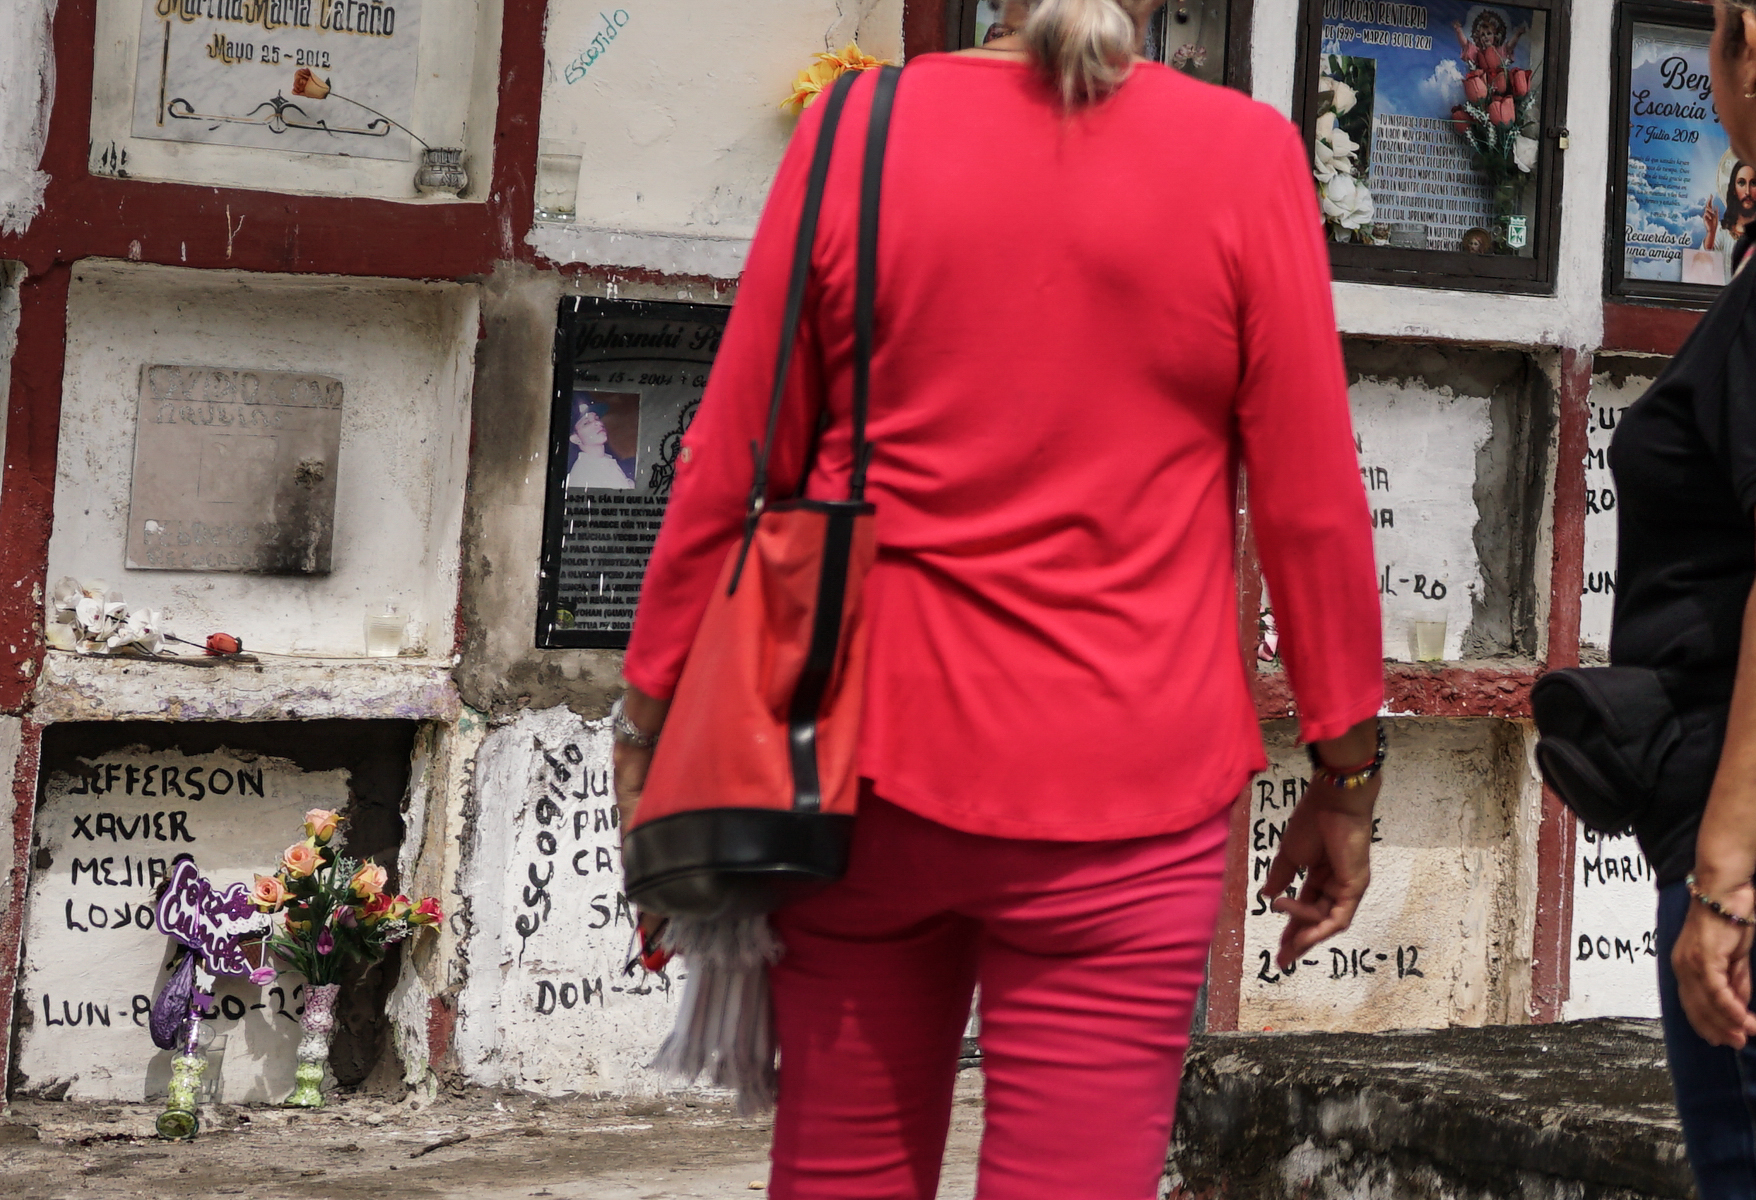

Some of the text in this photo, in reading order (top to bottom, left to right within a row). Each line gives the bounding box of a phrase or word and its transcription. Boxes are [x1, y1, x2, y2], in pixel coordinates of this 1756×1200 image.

[1376, 1, 1429, 30] RENTERIA
[206, 33, 331, 69] Mayo 25 2012
[1632, 88, 1707, 121] Escorcia
[1671, 128, 1700, 145] 2019
[1623, 224, 1692, 246] Recuerdos de
[1626, 246, 1647, 258] una
[69, 763, 265, 801] JEFFERSON
[71, 809, 196, 844] XAVIER
